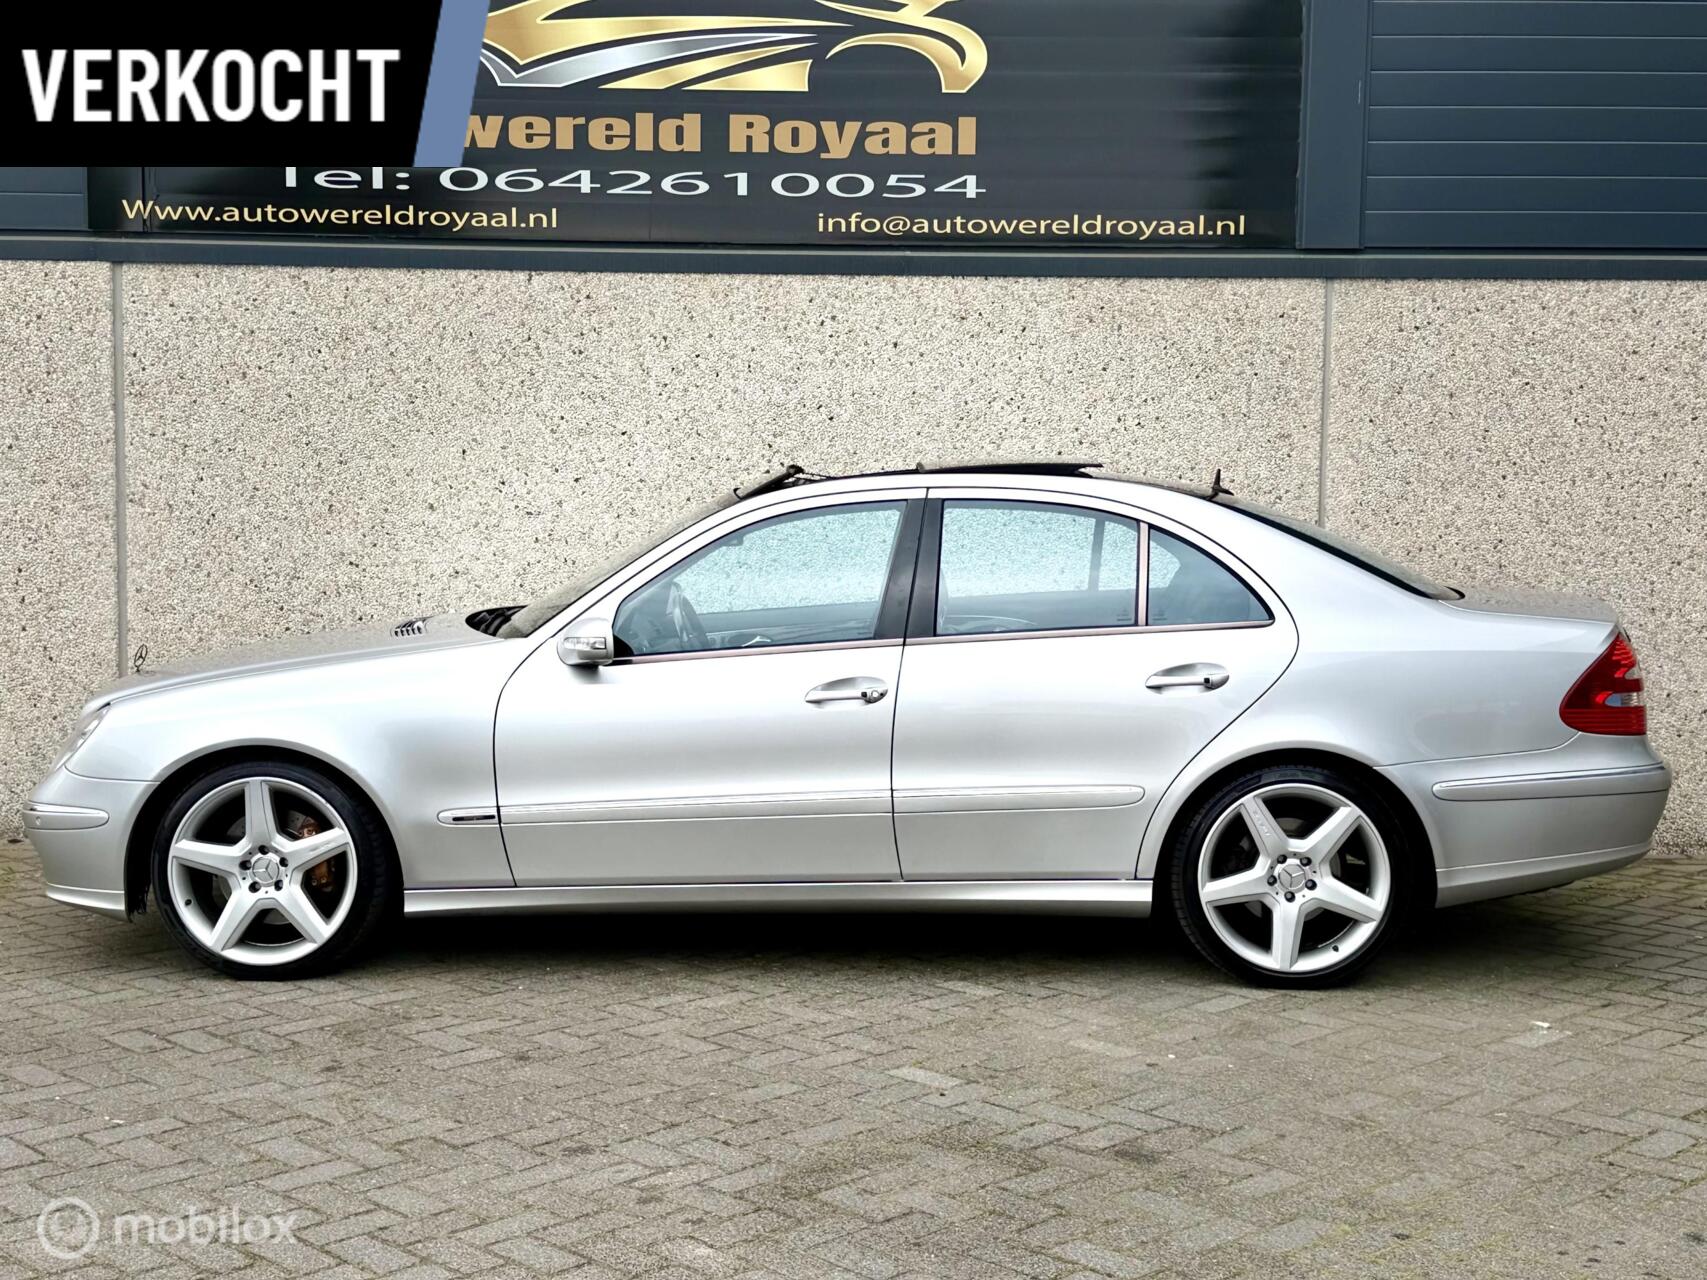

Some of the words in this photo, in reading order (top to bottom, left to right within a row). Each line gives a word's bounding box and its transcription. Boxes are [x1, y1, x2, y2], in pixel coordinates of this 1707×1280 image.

[729, 114, 977, 159] Royaal
[438, 166, 987, 199] 0642610054
[122, 199, 558, 232] Www.autowereldroyaal.nl
[818, 211, 1246, 241] info@autowereldroyaal.nl
